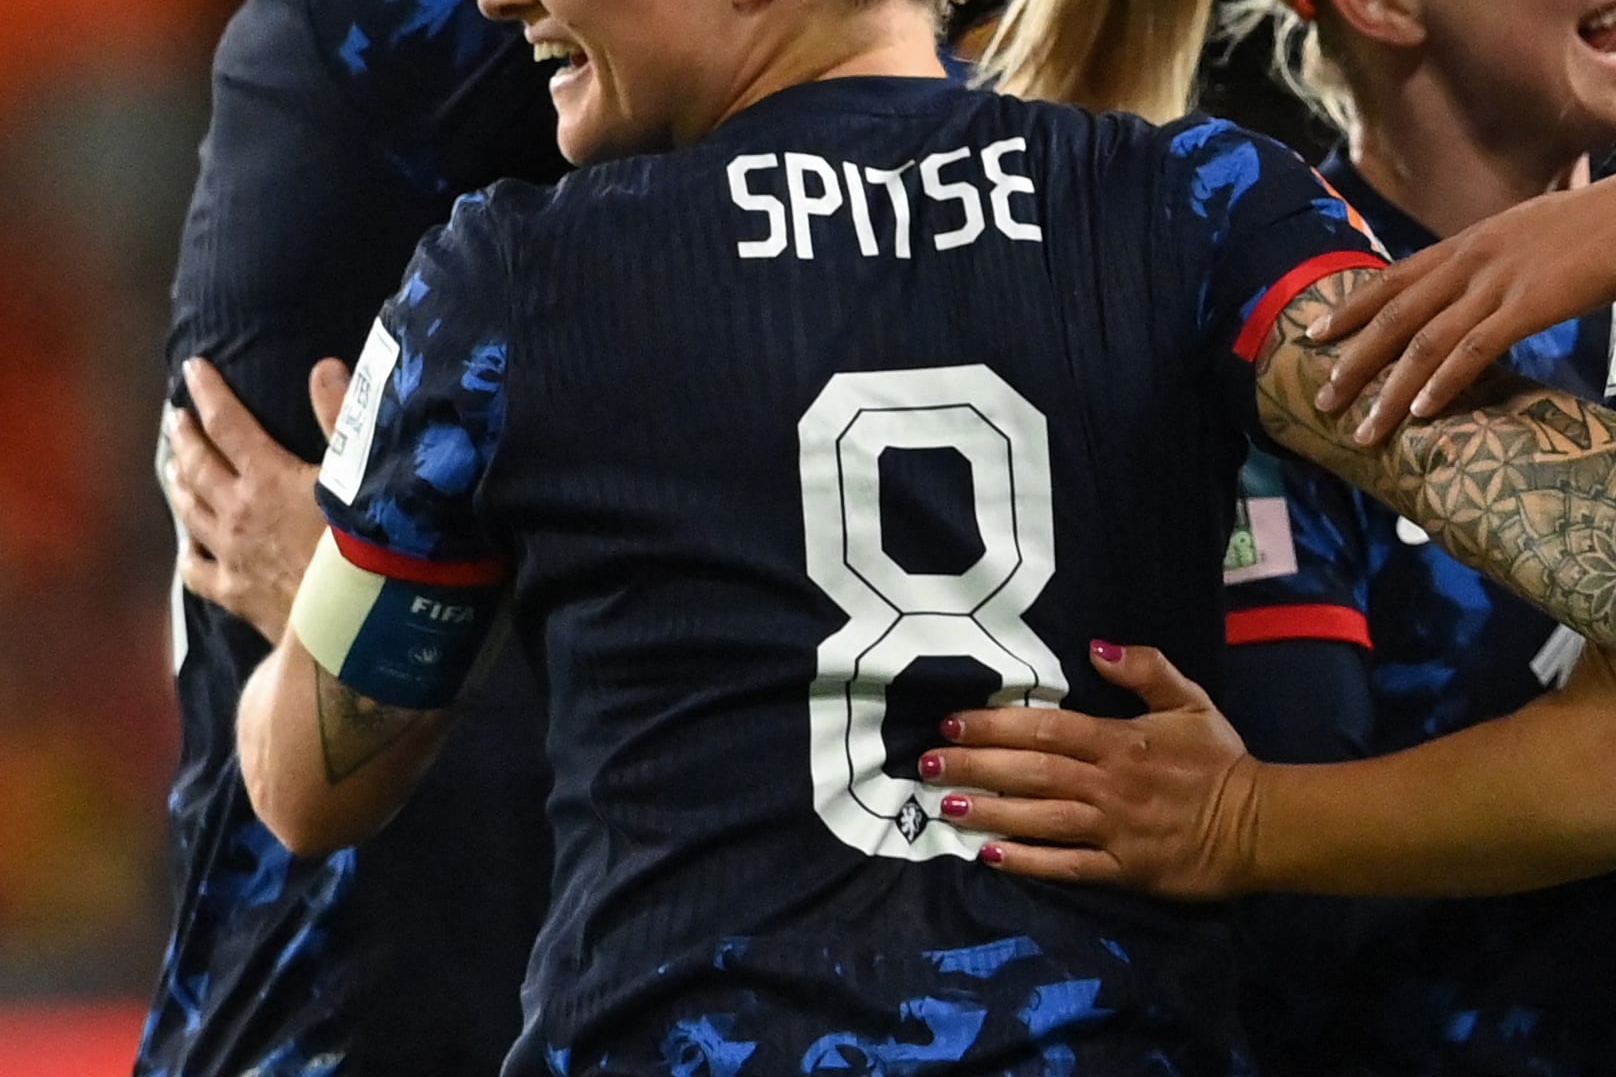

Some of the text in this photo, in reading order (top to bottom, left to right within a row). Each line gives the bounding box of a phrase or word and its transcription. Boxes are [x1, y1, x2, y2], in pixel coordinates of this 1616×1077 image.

[726, 137, 1043, 259] SPITSE
[411, 595, 475, 623] FIFA
[797, 363, 1070, 862] 8
